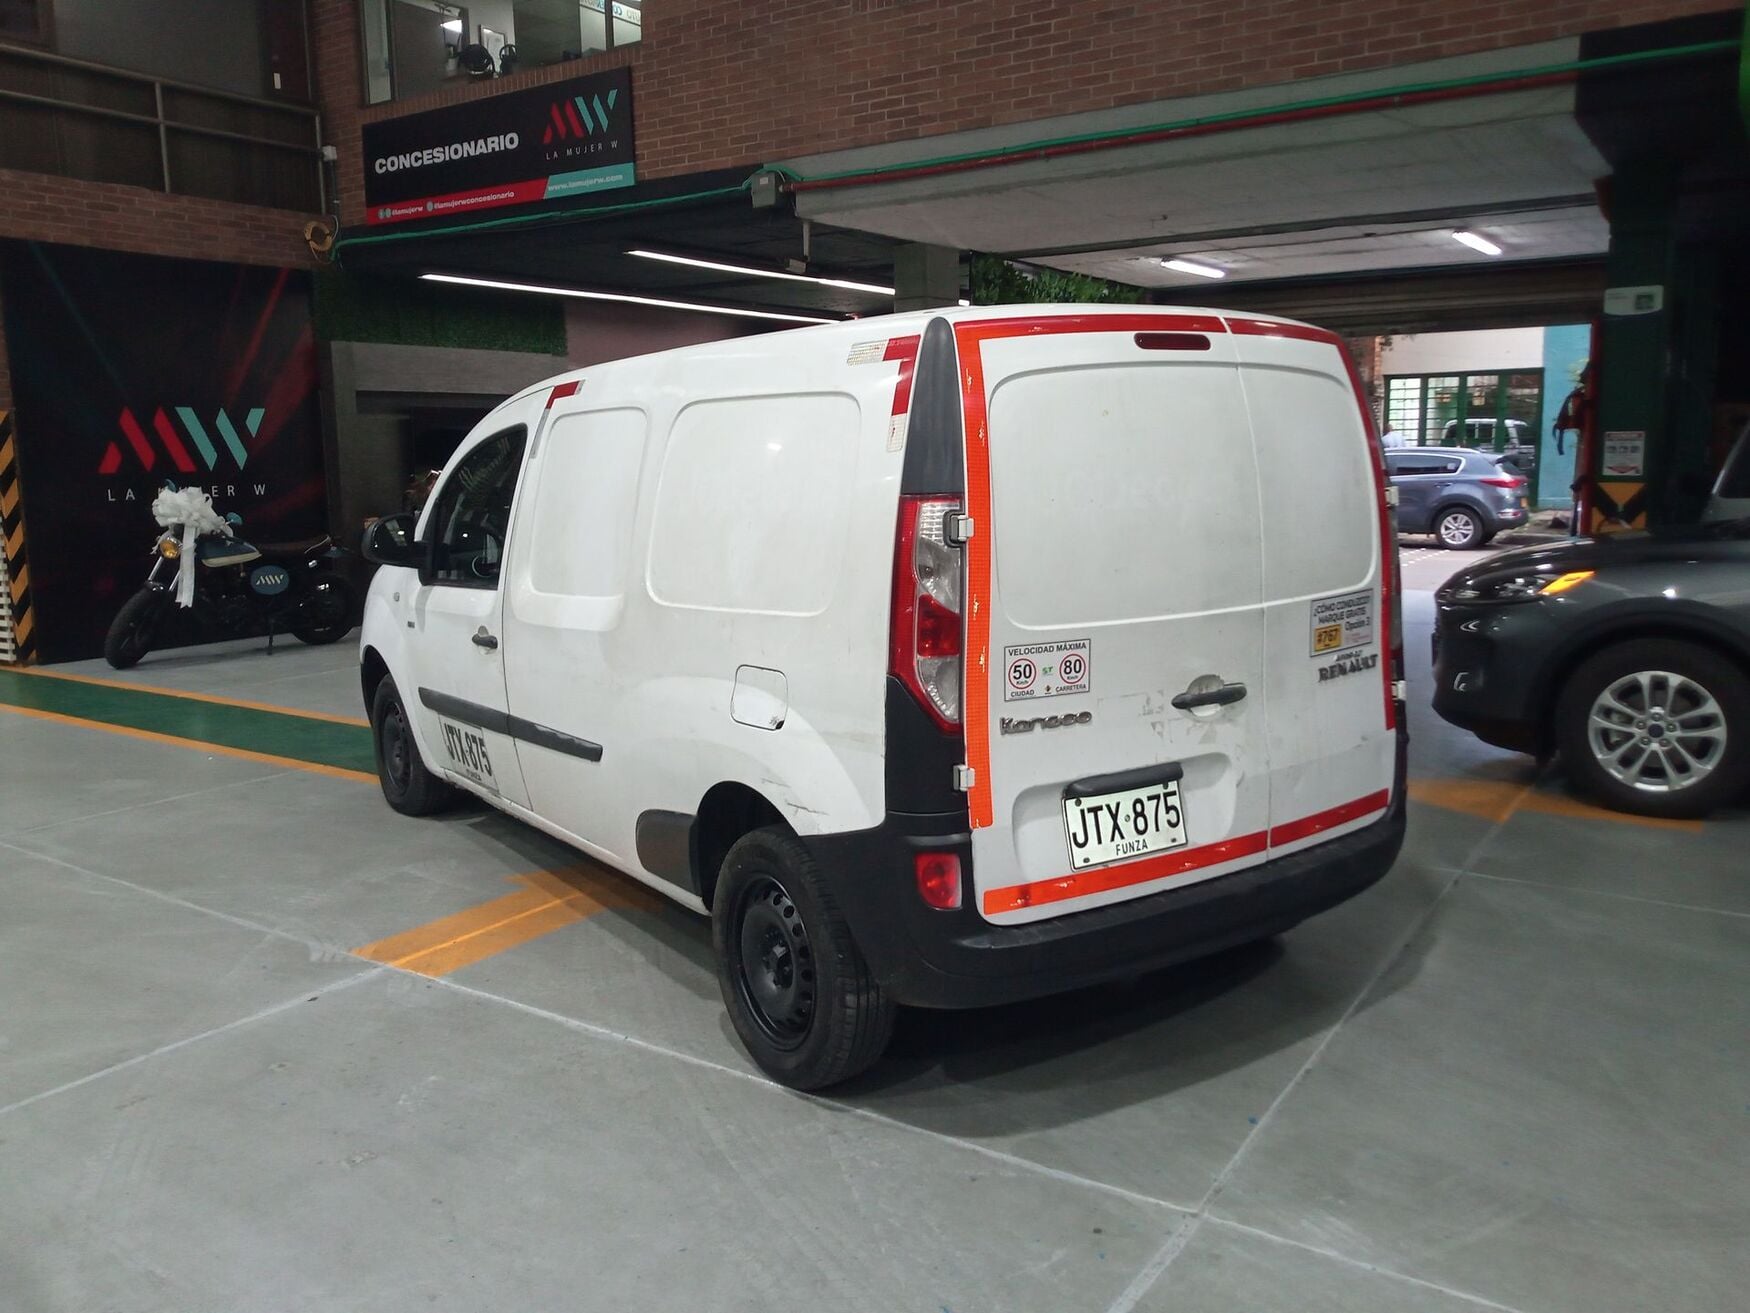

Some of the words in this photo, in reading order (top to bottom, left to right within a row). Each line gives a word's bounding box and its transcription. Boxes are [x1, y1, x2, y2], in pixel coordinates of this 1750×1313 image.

[374, 131, 520, 175] CONCESIONARIO
[546, 151, 559, 161] LA
[566, 143, 603, 157] MUJER
[610, 139, 618, 149] W
[107, 488, 136, 501] LA
[253, 483, 266, 496] W
[1008, 645, 1055, 657] VELOCIDAD
[1055, 642, 1087, 653] MÁXIMA
[1013, 663, 1032, 680] 50
[1063, 658, 1082, 675] 80
[1318, 653, 1378, 682] RENAULT
[1010, 689, 1035, 698] CIUDAD
[1055, 683, 1087, 693] CARRETERA
[1115, 838, 1149, 856] FUNZA
